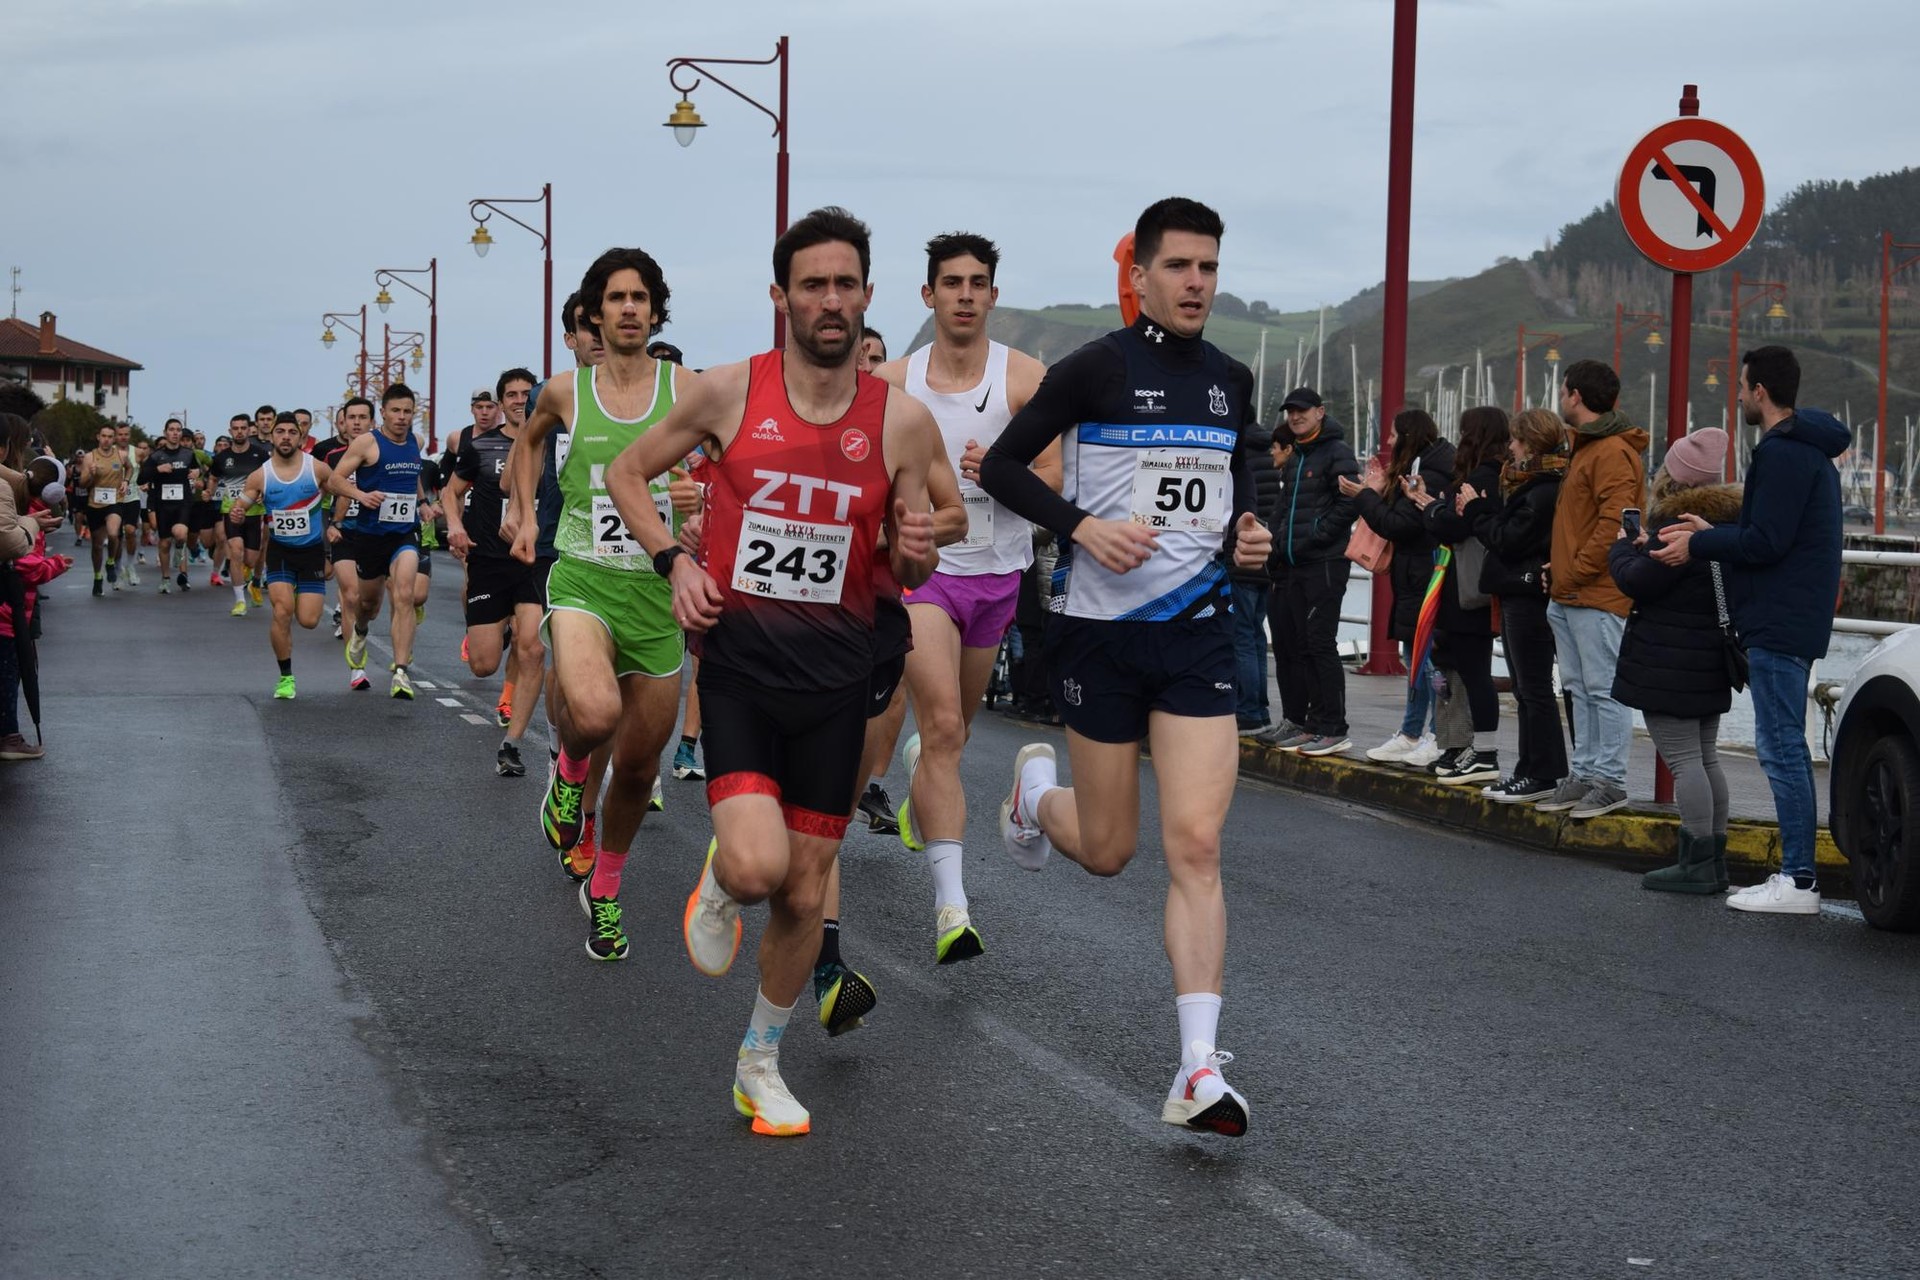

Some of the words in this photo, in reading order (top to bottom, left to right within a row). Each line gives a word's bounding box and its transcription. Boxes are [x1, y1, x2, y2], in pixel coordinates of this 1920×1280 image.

[1131, 429, 1232, 446] C.A.LAUDIO
[1141, 460, 1172, 469] ZUMAIAKO
[1176, 456, 1200, 466] XXXIX
[102, 492, 108, 500] 3
[749, 469, 862, 522] ZTT
[1155, 477, 1206, 513] 50
[390, 502, 408, 515] 16
[276, 517, 306, 530] 293
[748, 521, 782, 535] ZUMAIAKO
[785, 523, 816, 535] XXXIX
[743, 539, 837, 584] 243
